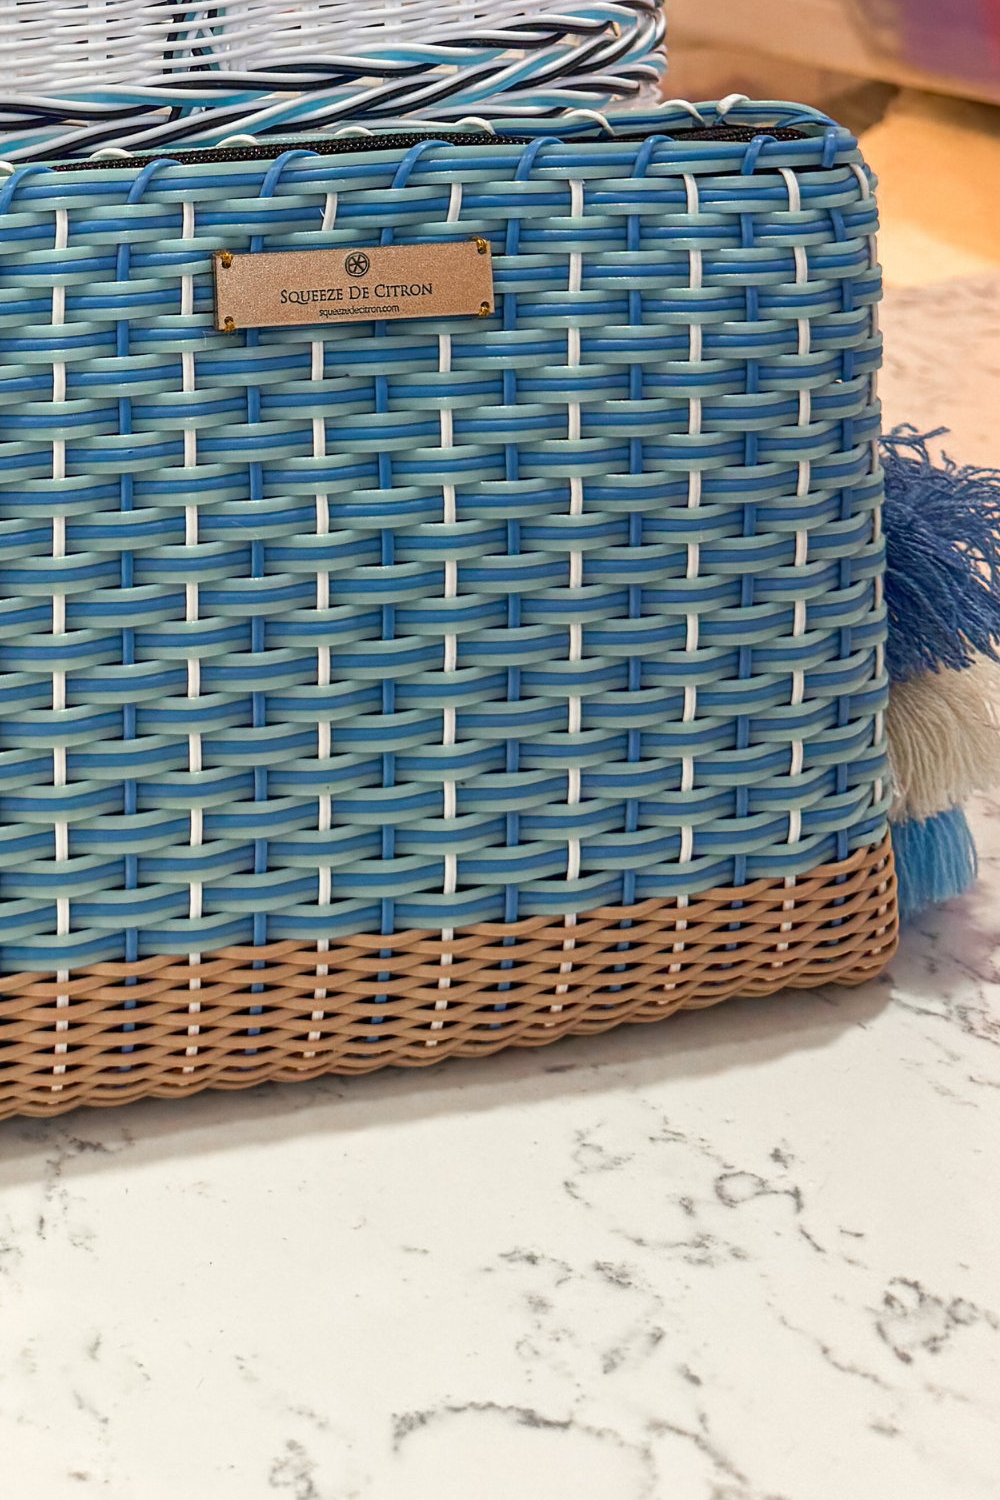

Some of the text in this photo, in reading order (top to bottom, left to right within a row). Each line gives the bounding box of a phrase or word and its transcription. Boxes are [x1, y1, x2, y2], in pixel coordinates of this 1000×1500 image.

[280, 282, 433, 305] SQUEEZE DE CITRON
[319, 304, 400, 318] squeezedecitron.com
